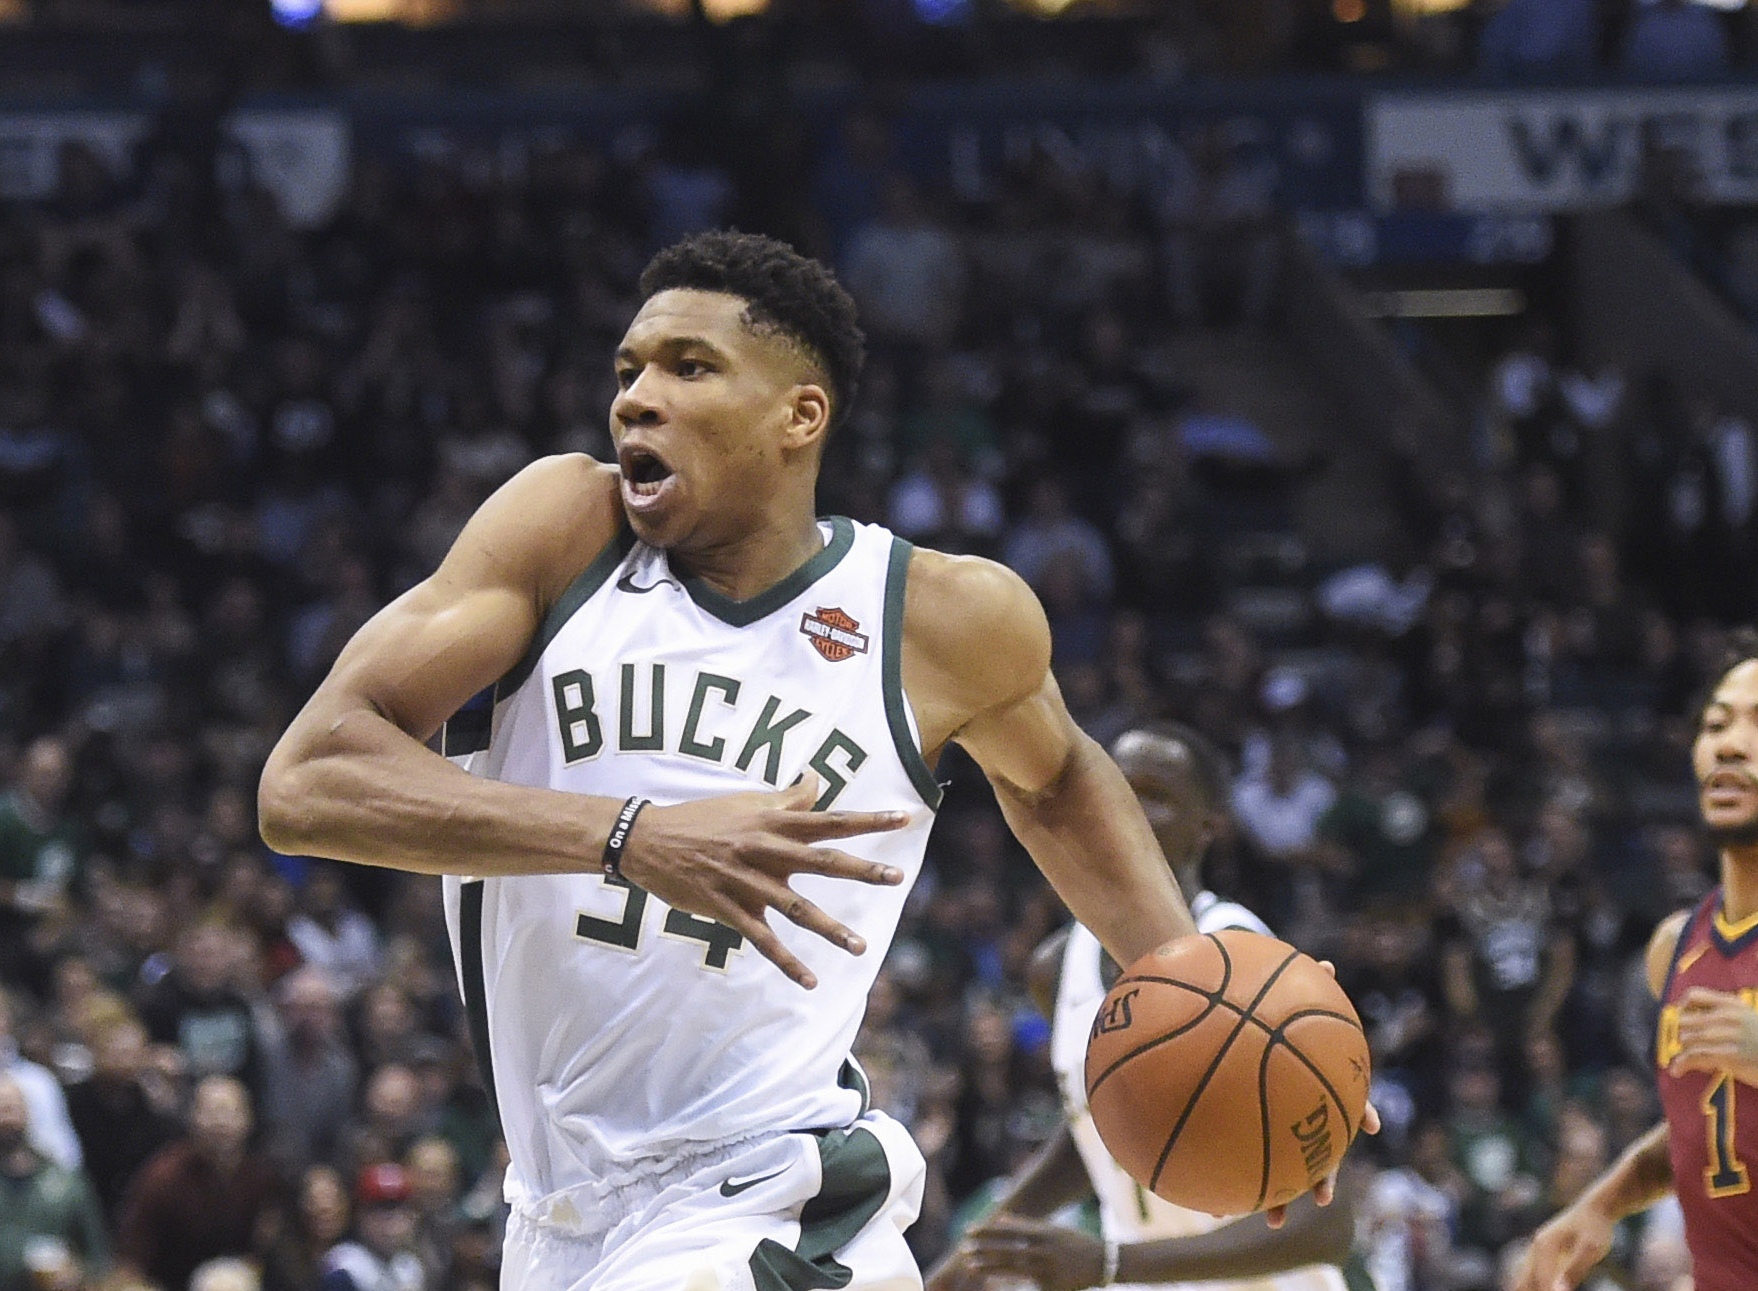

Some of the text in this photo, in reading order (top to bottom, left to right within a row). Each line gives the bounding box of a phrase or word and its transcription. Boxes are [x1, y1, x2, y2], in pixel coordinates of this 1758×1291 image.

[551, 663, 870, 812] BUCKS
[610, 831, 626, 848] On
[618, 822, 629, 830] a
[1701, 1069, 1751, 1198] 1
